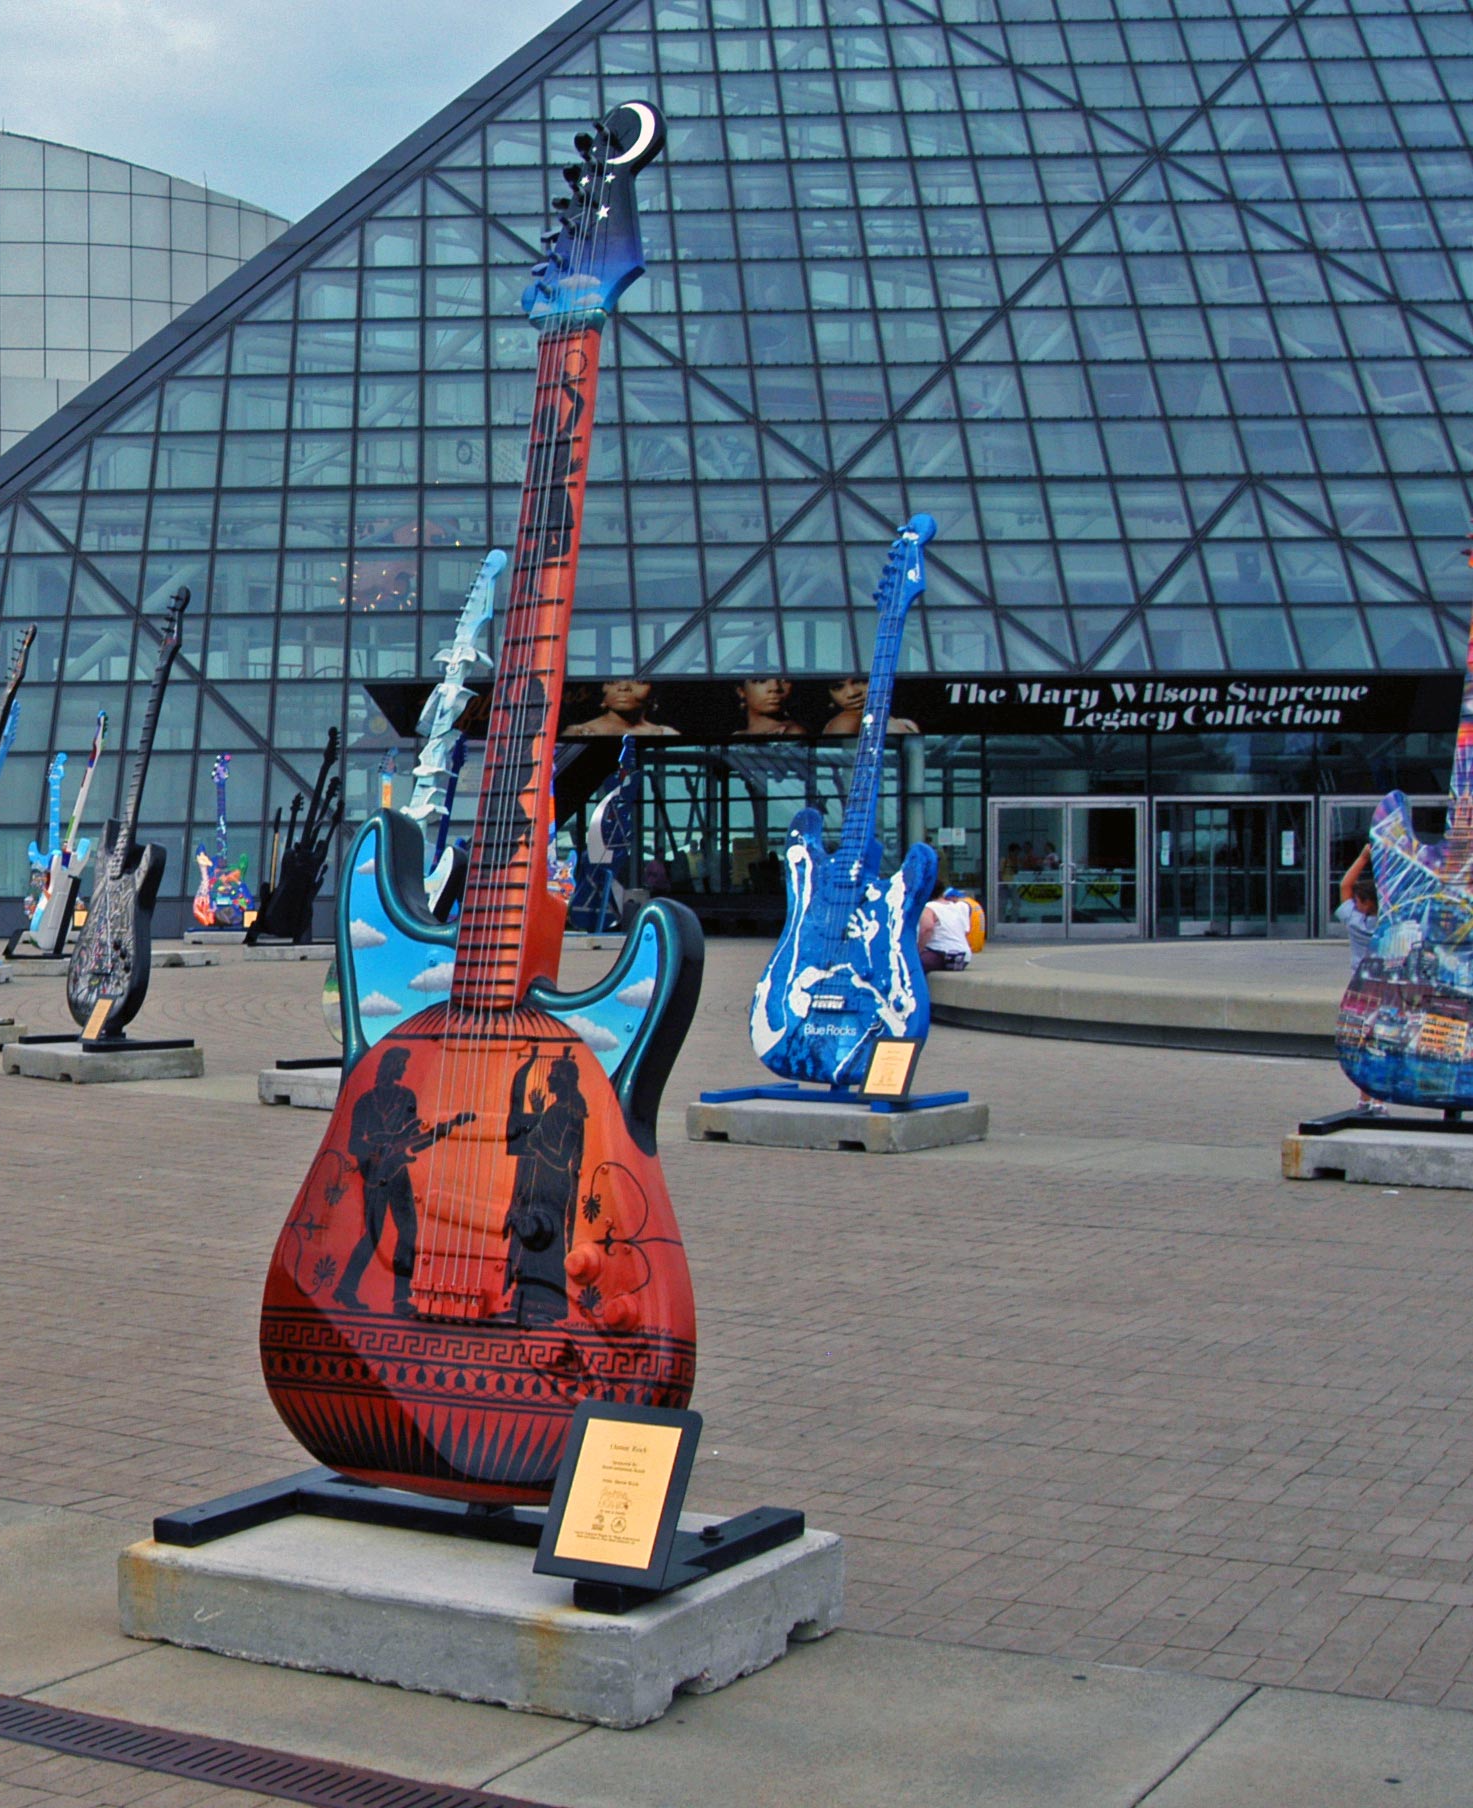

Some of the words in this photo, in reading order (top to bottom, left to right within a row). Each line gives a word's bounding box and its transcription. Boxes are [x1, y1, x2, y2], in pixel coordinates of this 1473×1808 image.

[945, 683, 1007, 704] The
[1016, 683, 1100, 709] Mary
[1110, 682, 1218, 703] Wilson
[1227, 681, 1368, 706] Supreme
[1063, 706, 1177, 731] Legacy
[1183, 704, 1341, 726] Collection
[804, 1023, 826, 1037] Blue
[826, 1024, 857, 1037] Rocks
